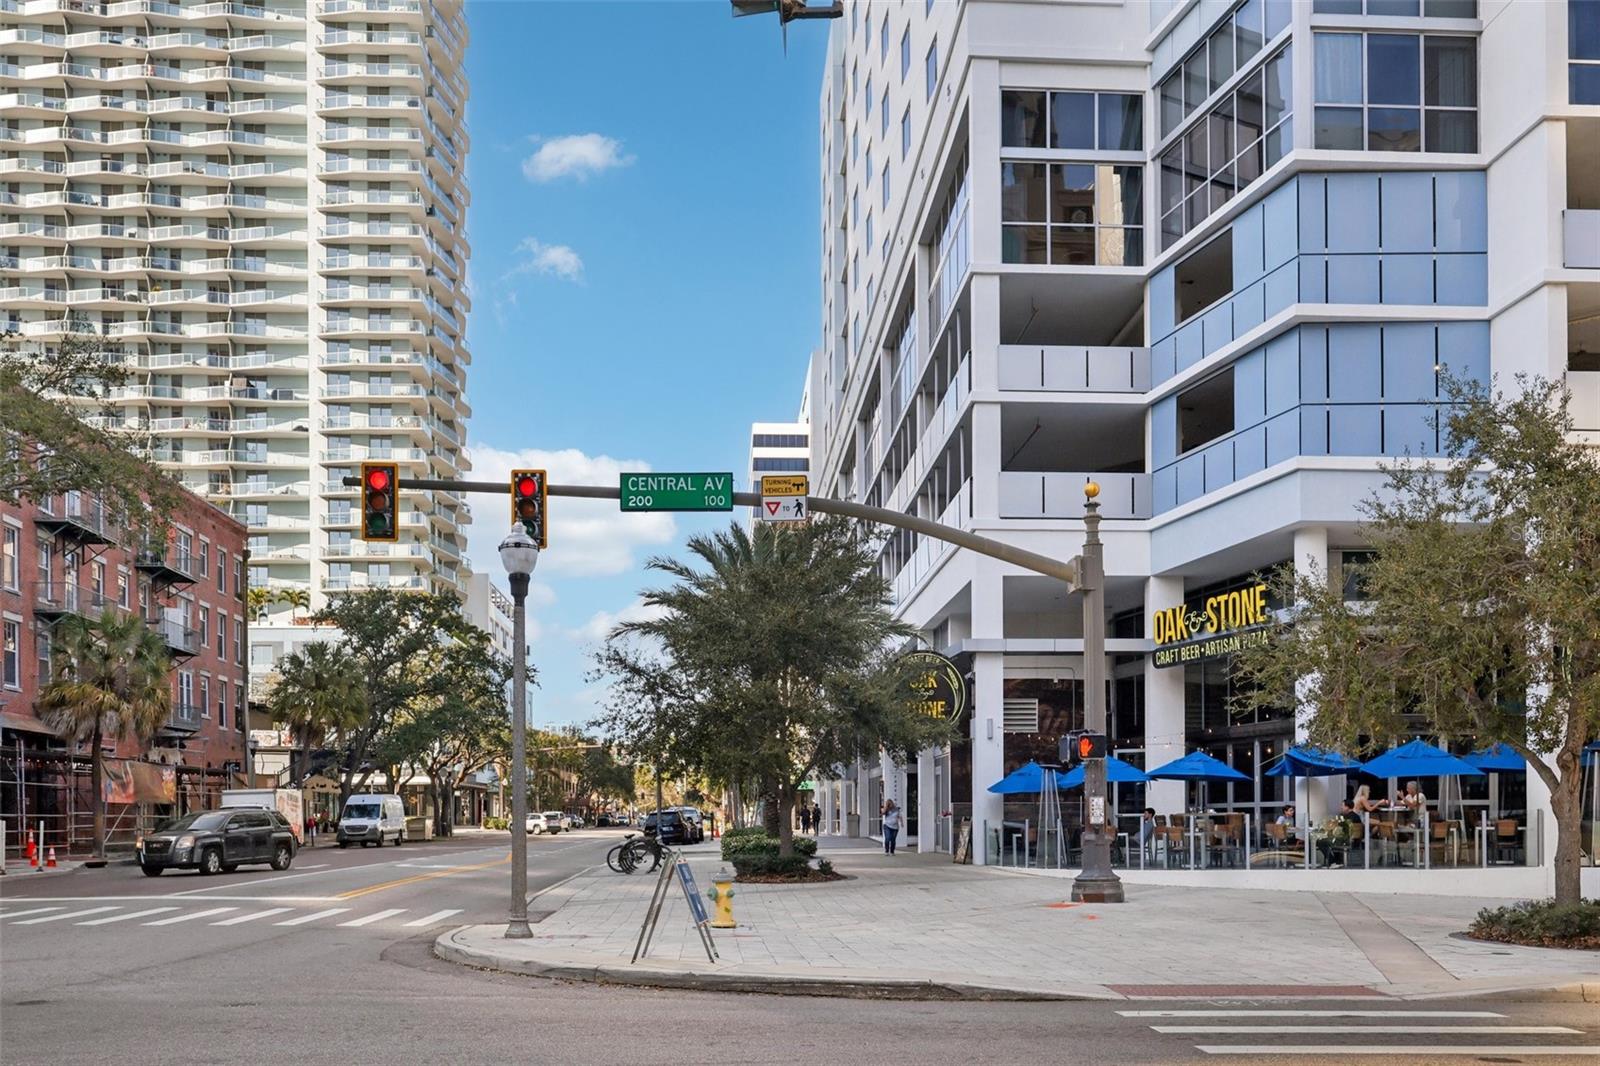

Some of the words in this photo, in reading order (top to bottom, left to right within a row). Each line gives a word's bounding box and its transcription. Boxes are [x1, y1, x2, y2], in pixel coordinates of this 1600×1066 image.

[628, 477, 696, 491] CENTRAL
[704, 477, 725, 491] AV
[628, 496, 653, 507] 200
[704, 496, 725, 506] 100
[1153, 604, 1188, 645] OAK
[1184, 609, 1208, 633] &
[1205, 584, 1267, 634] STONE
[1155, 648, 1178, 665] CRAFT
[1181, 643, 1200, 661] BEER
[1205, 636, 1240, 657] ARTISAN
